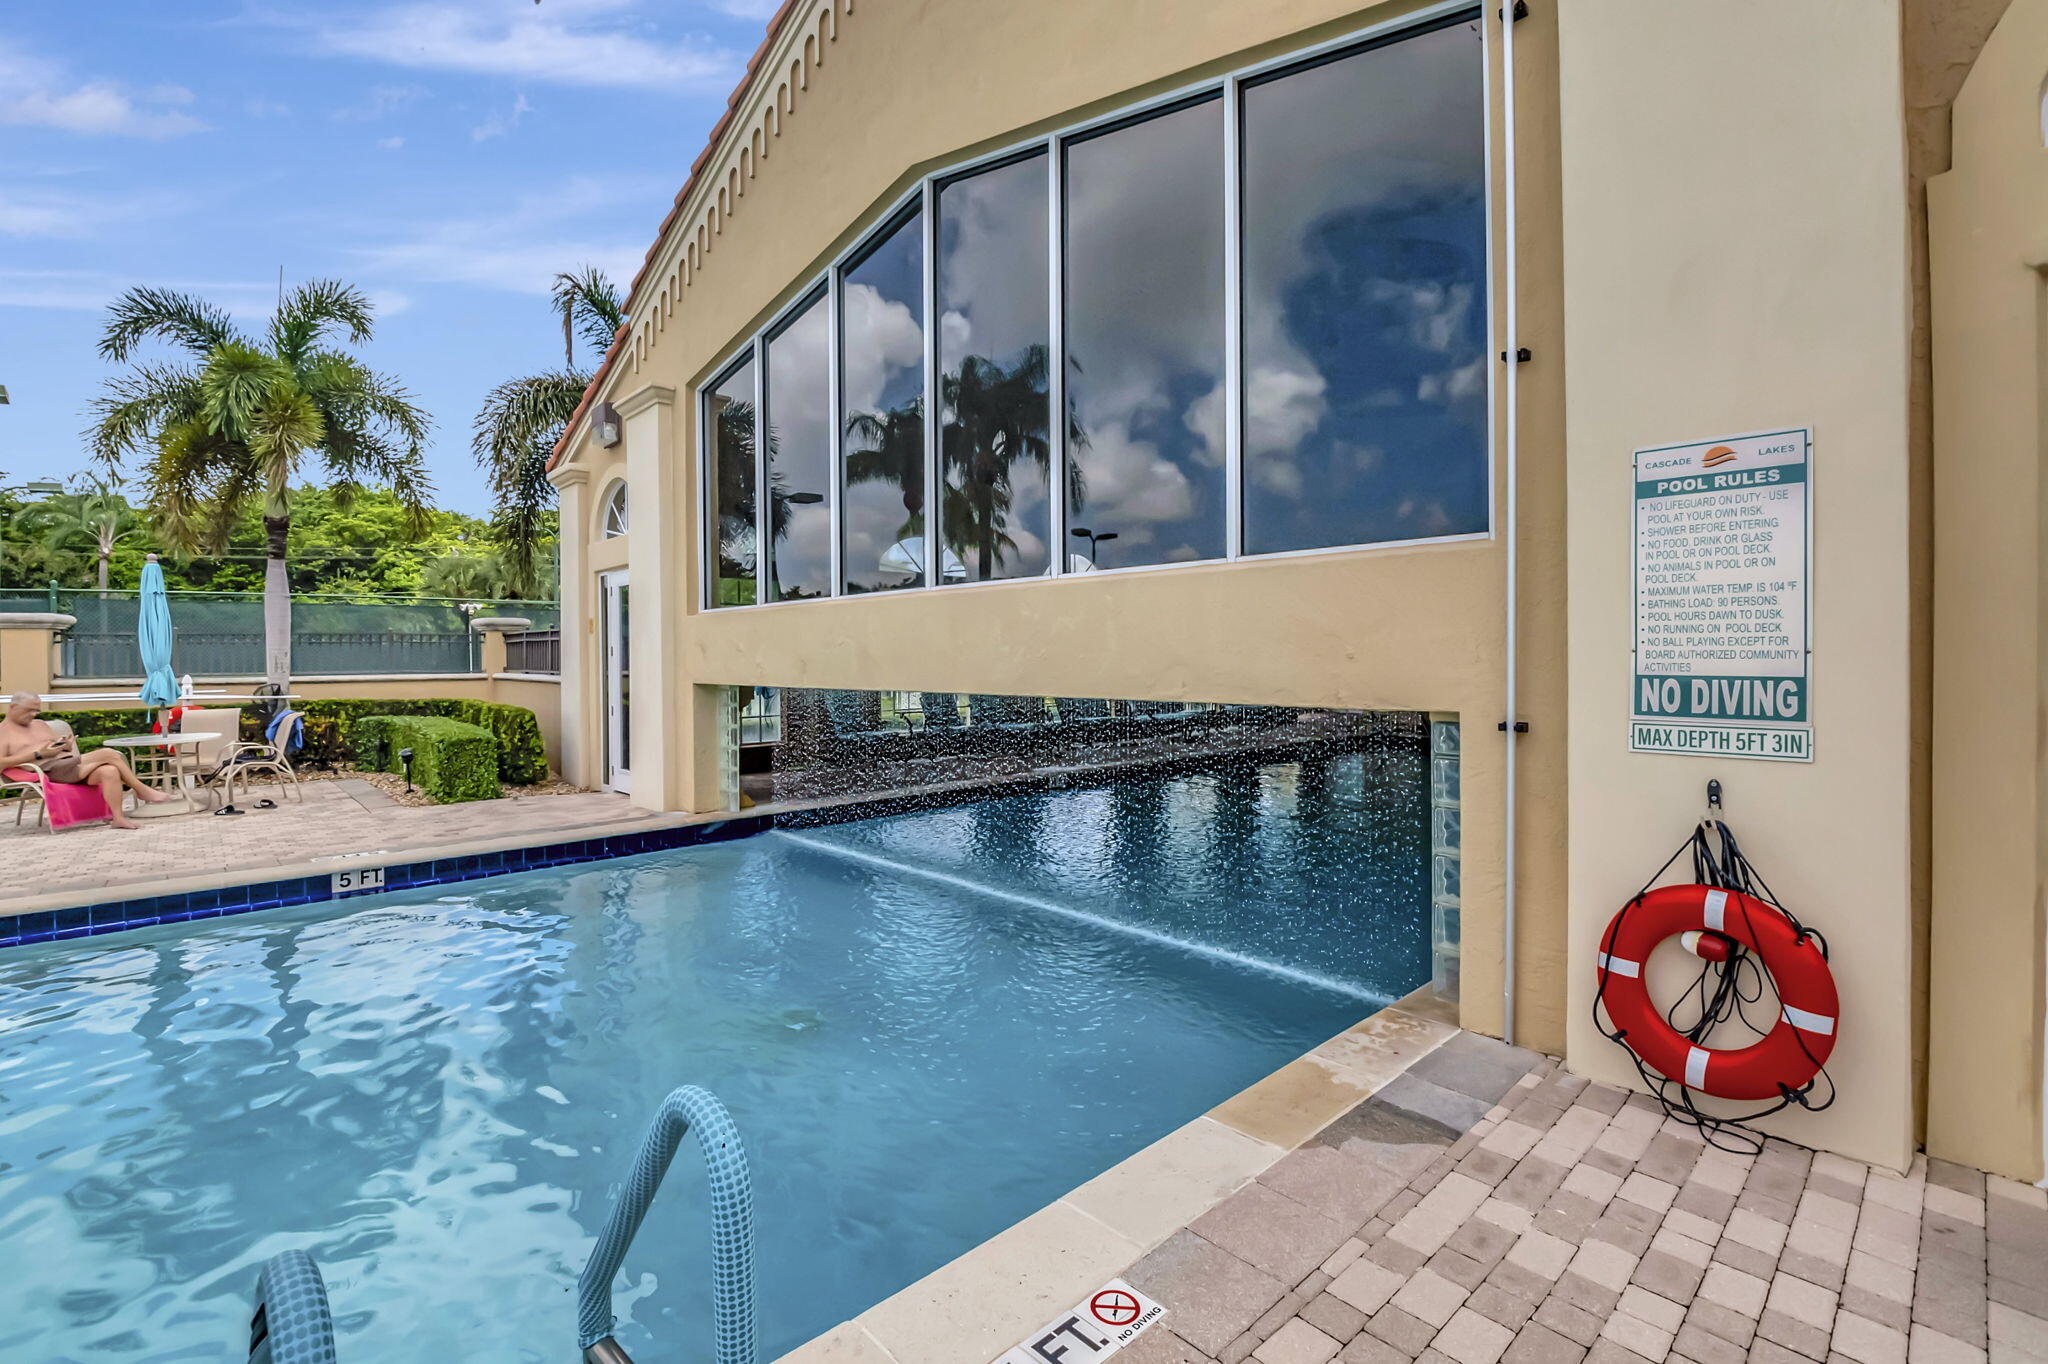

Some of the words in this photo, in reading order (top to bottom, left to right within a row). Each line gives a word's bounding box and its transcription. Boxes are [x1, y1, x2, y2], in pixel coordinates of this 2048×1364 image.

[1645, 458, 1692, 469] CASCADE
[1758, 444, 1795, 456] LAKES
[1658, 478, 1708, 494] POOL
[1714, 469, 1780, 488] RULES
[1649, 502, 1663, 512] NO
[1665, 497, 1716, 510] LIFEGUARD
[1719, 495, 1732, 506] ON
[1735, 492, 1761, 504] DUTY
[1769, 489, 1789, 500] USE
[1648, 514, 1671, 525] POOL
[1673, 512, 1684, 522] AT
[1686, 510, 1712, 520] YOUR
[1715, 508, 1738, 518] OWN
[1648, 526, 1686, 537] SHOWER
[1689, 522, 1726, 534] BEFORE
[1648, 540, 1660, 550] NO
[1694, 536, 1722, 546] DRINK
[1724, 534, 1738, 544] OR
[1741, 532, 1773, 543] GLASS
[1646, 552, 1654, 560] IN
[1656, 550, 1680, 560] POOL
[1682, 548, 1696, 558] OR
[1699, 548, 1712, 558] ON
[1715, 546, 1740, 556] POOL
[1648, 564, 1660, 572] NO
[1663, 561, 1701, 572] ANIMALS
[1704, 560, 1713, 570] IN
[1716, 559, 1741, 569] POOL
[1744, 558, 1758, 568] OR
[1761, 557, 1776, 567] ON
[1646, 574, 1668, 584] POOL
[1648, 586, 1690, 596] MAXIMUM
[1692, 584, 1724, 594] WATER
[1756, 582, 1766, 592] IS
[1770, 582, 1784, 592] 104
[1648, 599, 1686, 609] BATHING
[1718, 598, 1728, 607] 90
[1648, 612, 1672, 621] POOL
[1674, 612, 1706, 620] HOURS
[1709, 610, 1736, 620] DAWN
[1739, 610, 1752, 619] TO
[1648, 625, 1660, 634] NO
[1663, 624, 1704, 634] RUNNING
[1707, 624, 1720, 634] ON
[1726, 623, 1752, 632] POOL
[1648, 638, 1660, 646] NO
[1663, 638, 1684, 646] BALL
[1686, 637, 1724, 646] PLAYING
[1728, 636, 1766, 646] EXCEPT
[1769, 636, 1789, 646] FOR
[1646, 650, 1675, 659] BOARD
[1678, 650, 1736, 660] AUTHORIZED
[1740, 650, 1800, 660] COMMUNITY
[1644, 663, 1692, 672] ACTIVITIES
[1641, 678, 1681, 714] NO
[1691, 679, 1798, 718] DIVING
[1638, 728, 1672, 747] MAX
[1678, 730, 1730, 750] DEPTH
[1736, 732, 1767, 752] 5FT
[1772, 734, 1802, 754] 3IN
[339, 872, 352, 888] 5
[360, 868, 382, 884] FT.
[1118, 1329, 1133, 1342] NO
[1132, 1306, 1162, 1330] DIVING
[1031, 1316, 1110, 1364] FT.
